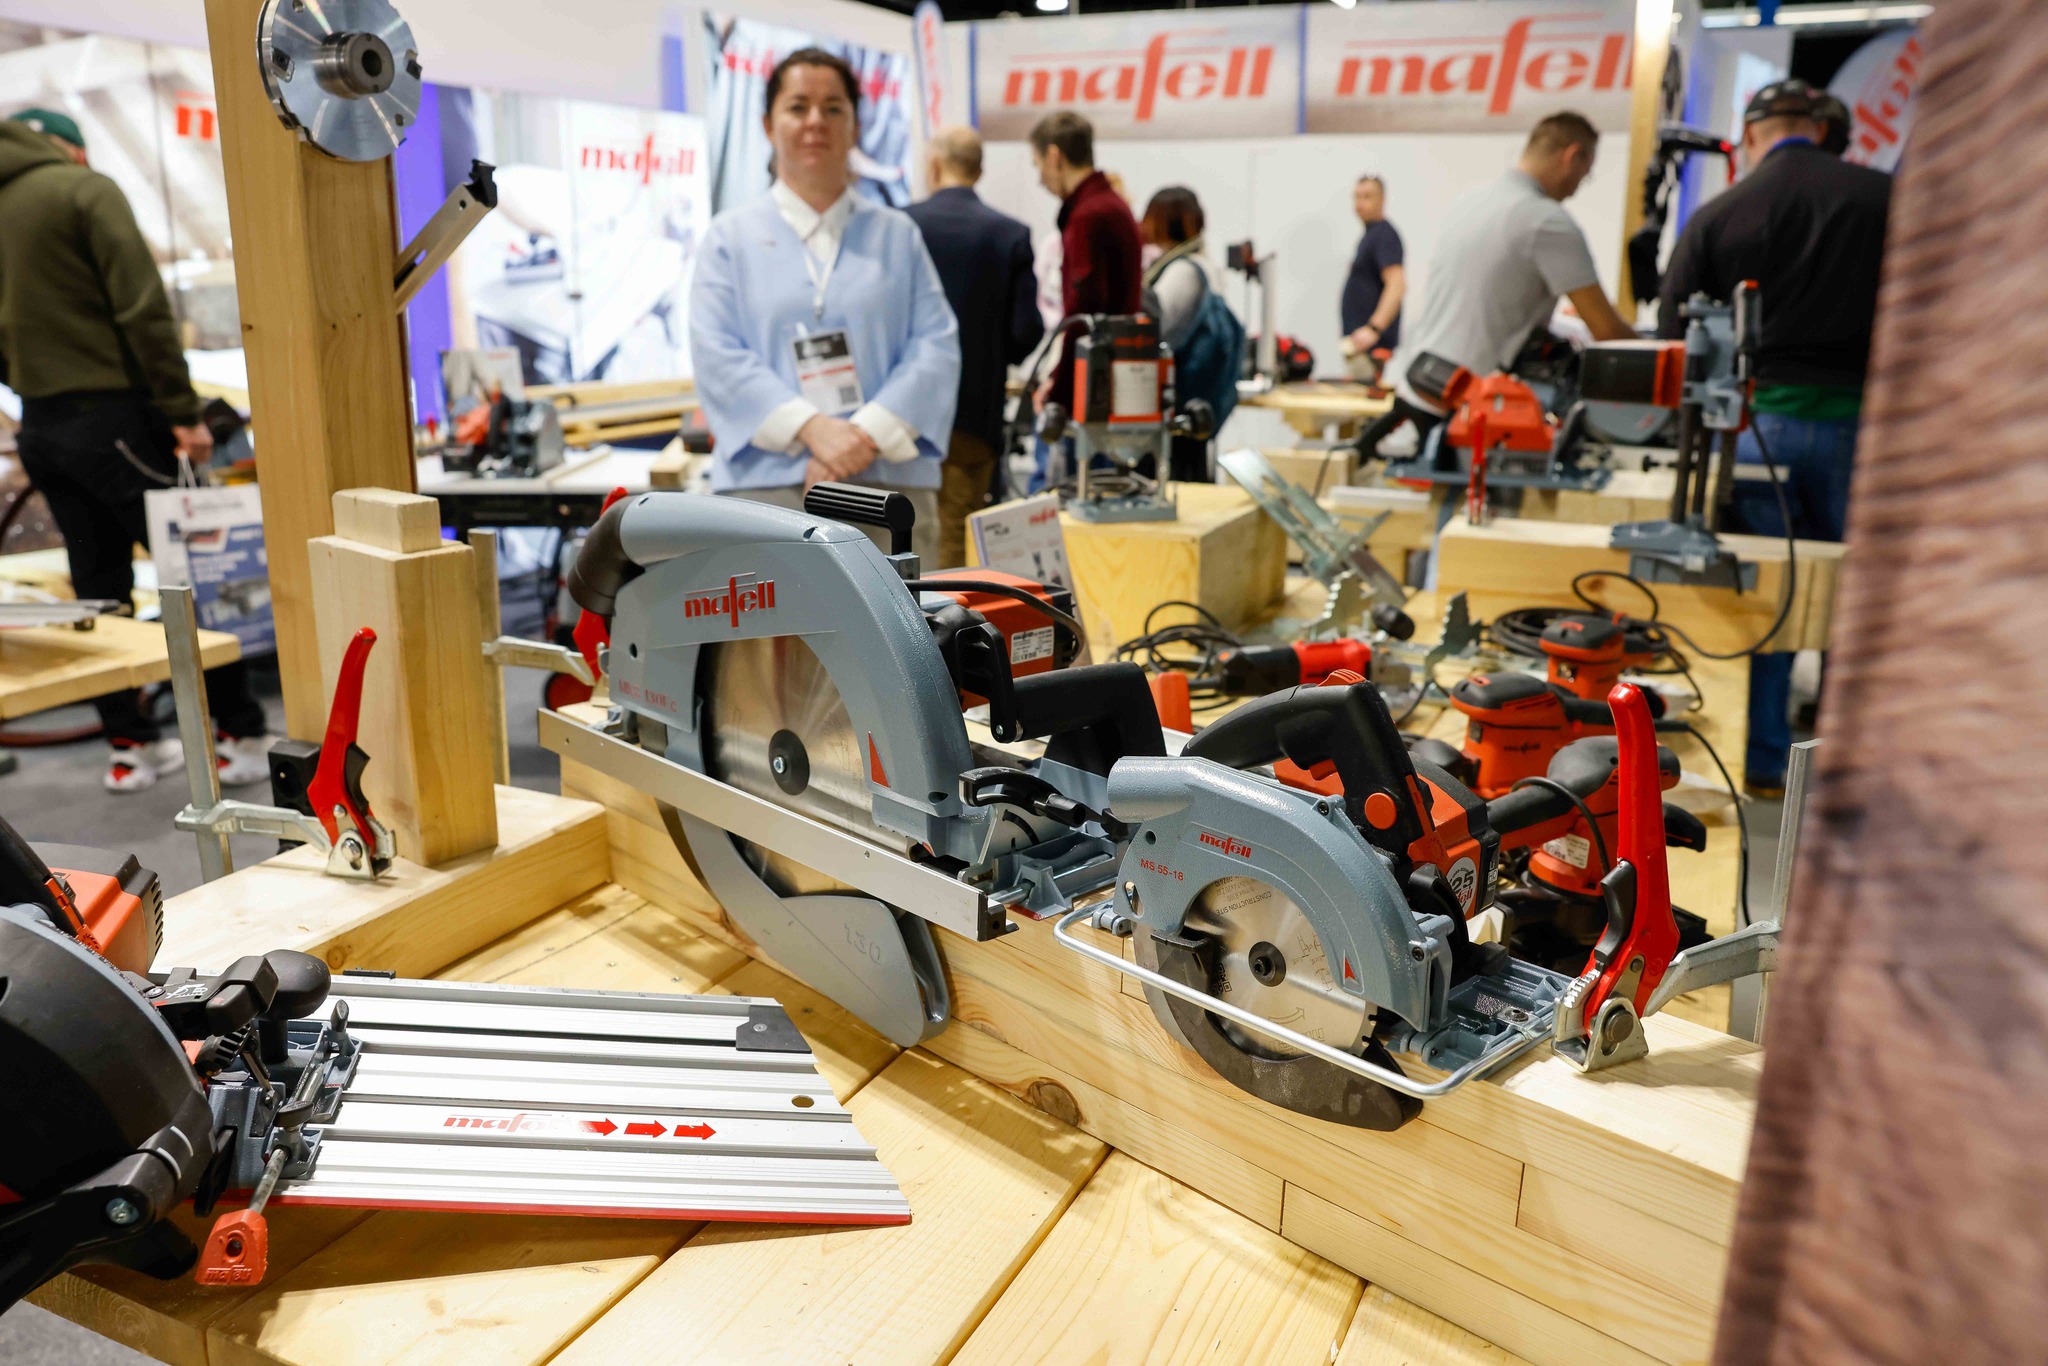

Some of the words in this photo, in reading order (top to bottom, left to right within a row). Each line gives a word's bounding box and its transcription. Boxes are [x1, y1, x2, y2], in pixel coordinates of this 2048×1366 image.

[1002, 28, 1275, 121] mafell
[684, 572, 775, 628] mafell
[1199, 831, 1252, 859] mafell
[1140, 858, 1156, 872] MS
[1157, 864, 1184, 881] 55-18
[1216, 906, 1230, 916] SITE
[1230, 891, 1272, 911] CONSTRUCTION
